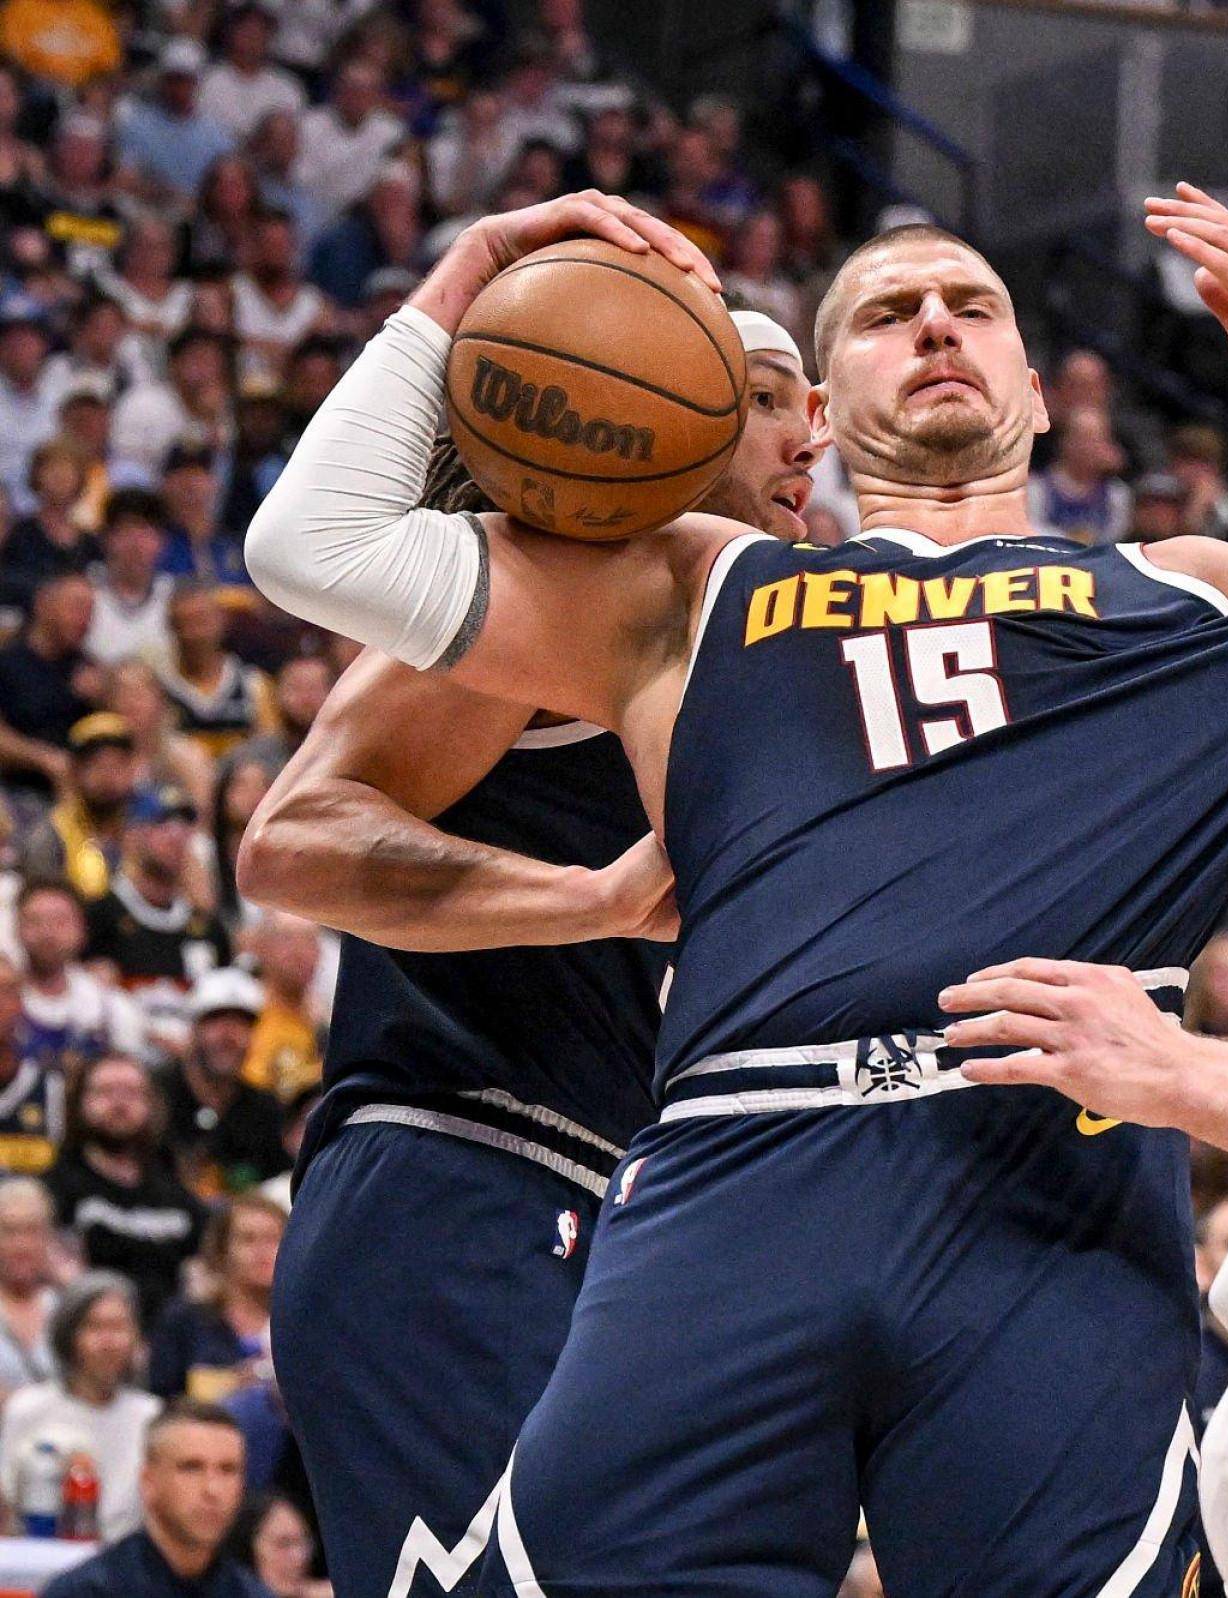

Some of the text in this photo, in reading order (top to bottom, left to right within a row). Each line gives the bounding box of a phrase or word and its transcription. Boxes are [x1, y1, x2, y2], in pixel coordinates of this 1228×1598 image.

[470, 355, 655, 462] Wilson
[743, 564, 1102, 648] DENVER
[837, 617, 1013, 774] 15
